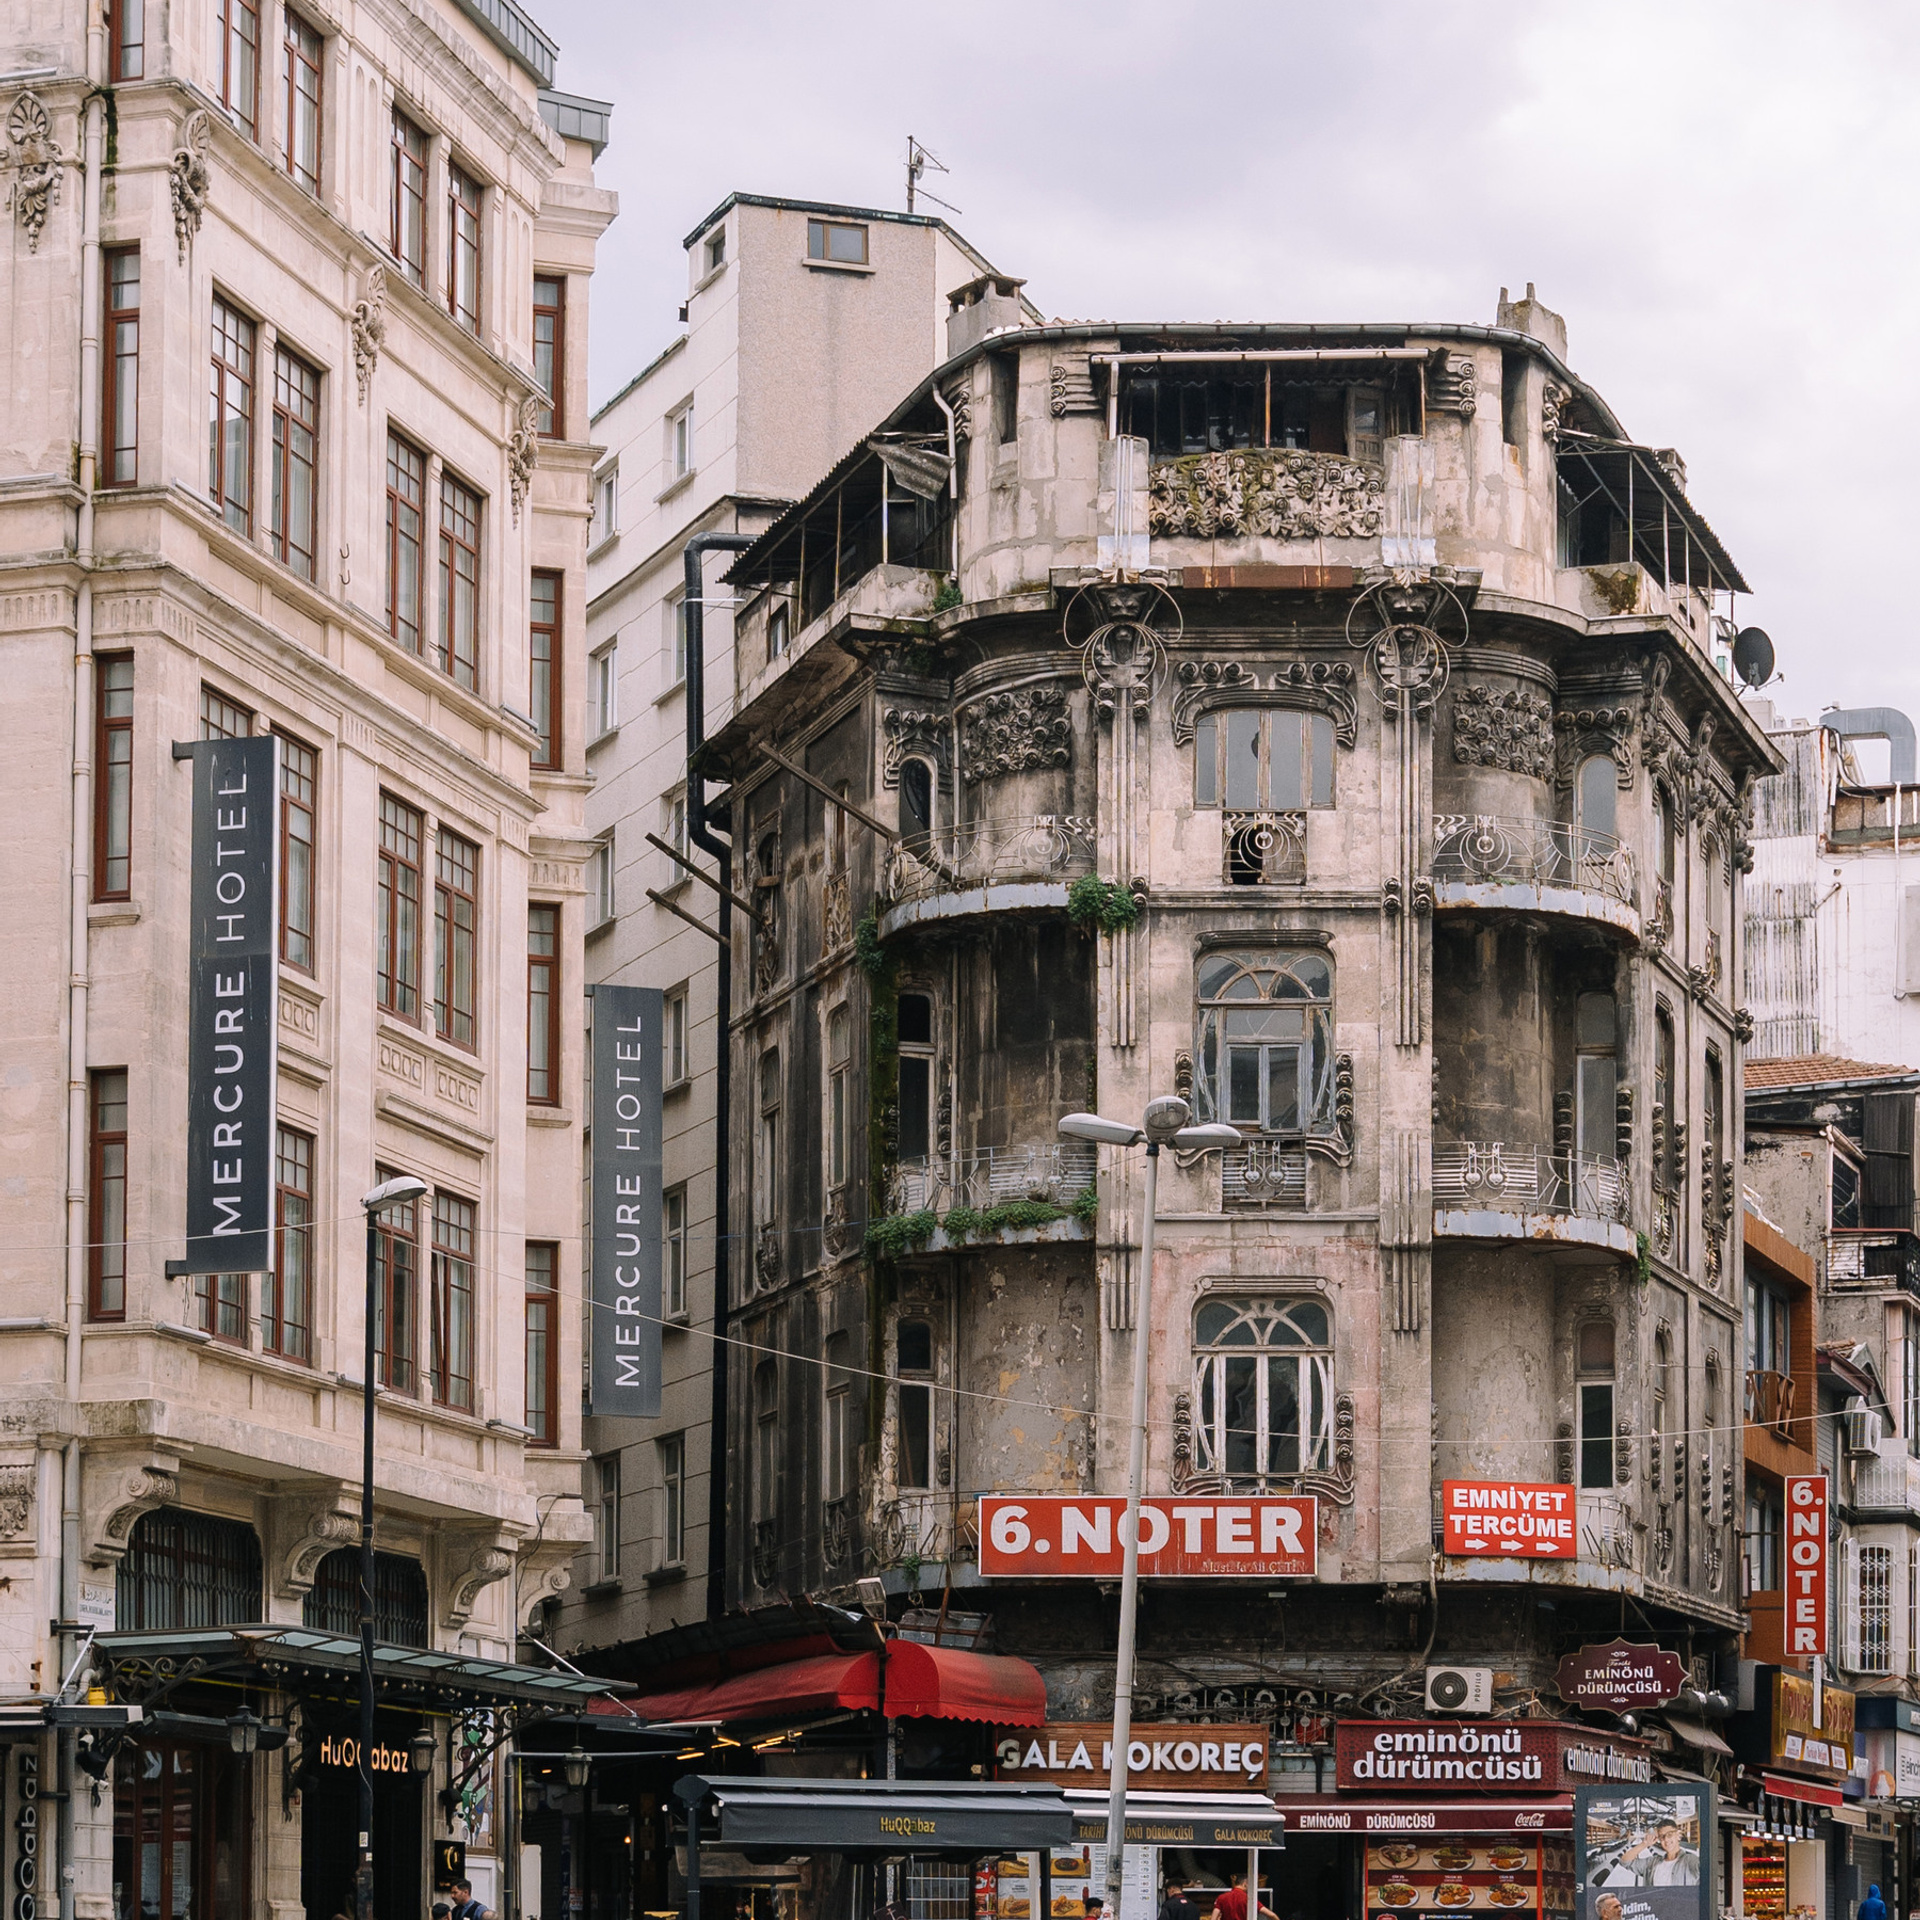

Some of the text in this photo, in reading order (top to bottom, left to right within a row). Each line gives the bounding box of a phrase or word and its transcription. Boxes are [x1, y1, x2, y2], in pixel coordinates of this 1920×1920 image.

[212, 772, 249, 1237] MERCURE HOTEL
[615, 1016, 643, 1388] MERCURE HOTEL
[1453, 1486, 1567, 1511] EMNİYET
[1450, 1513, 1572, 1538] TERCÜME
[1585, 1666, 1654, 1680] EMİNÖNÜ
[1577, 1681, 1662, 1694] DÜRÜMCÜSÜ
[1374, 1728, 1522, 1753] eminönü
[321, 1735, 409, 1773] HuQabaz
[997, 1738, 1094, 1770] GALA
[1353, 1751, 1542, 1780] dürümcüsü
[880, 1816, 935, 1835] HuQQabaz
[1079, 1822, 1106, 1840] TARİHİ
[1300, 1812, 1436, 1829] EMİNÖNÜ DÜRÜMCÜSÜ
[1214, 1828, 1273, 1845] GALA KOKOREÇ
